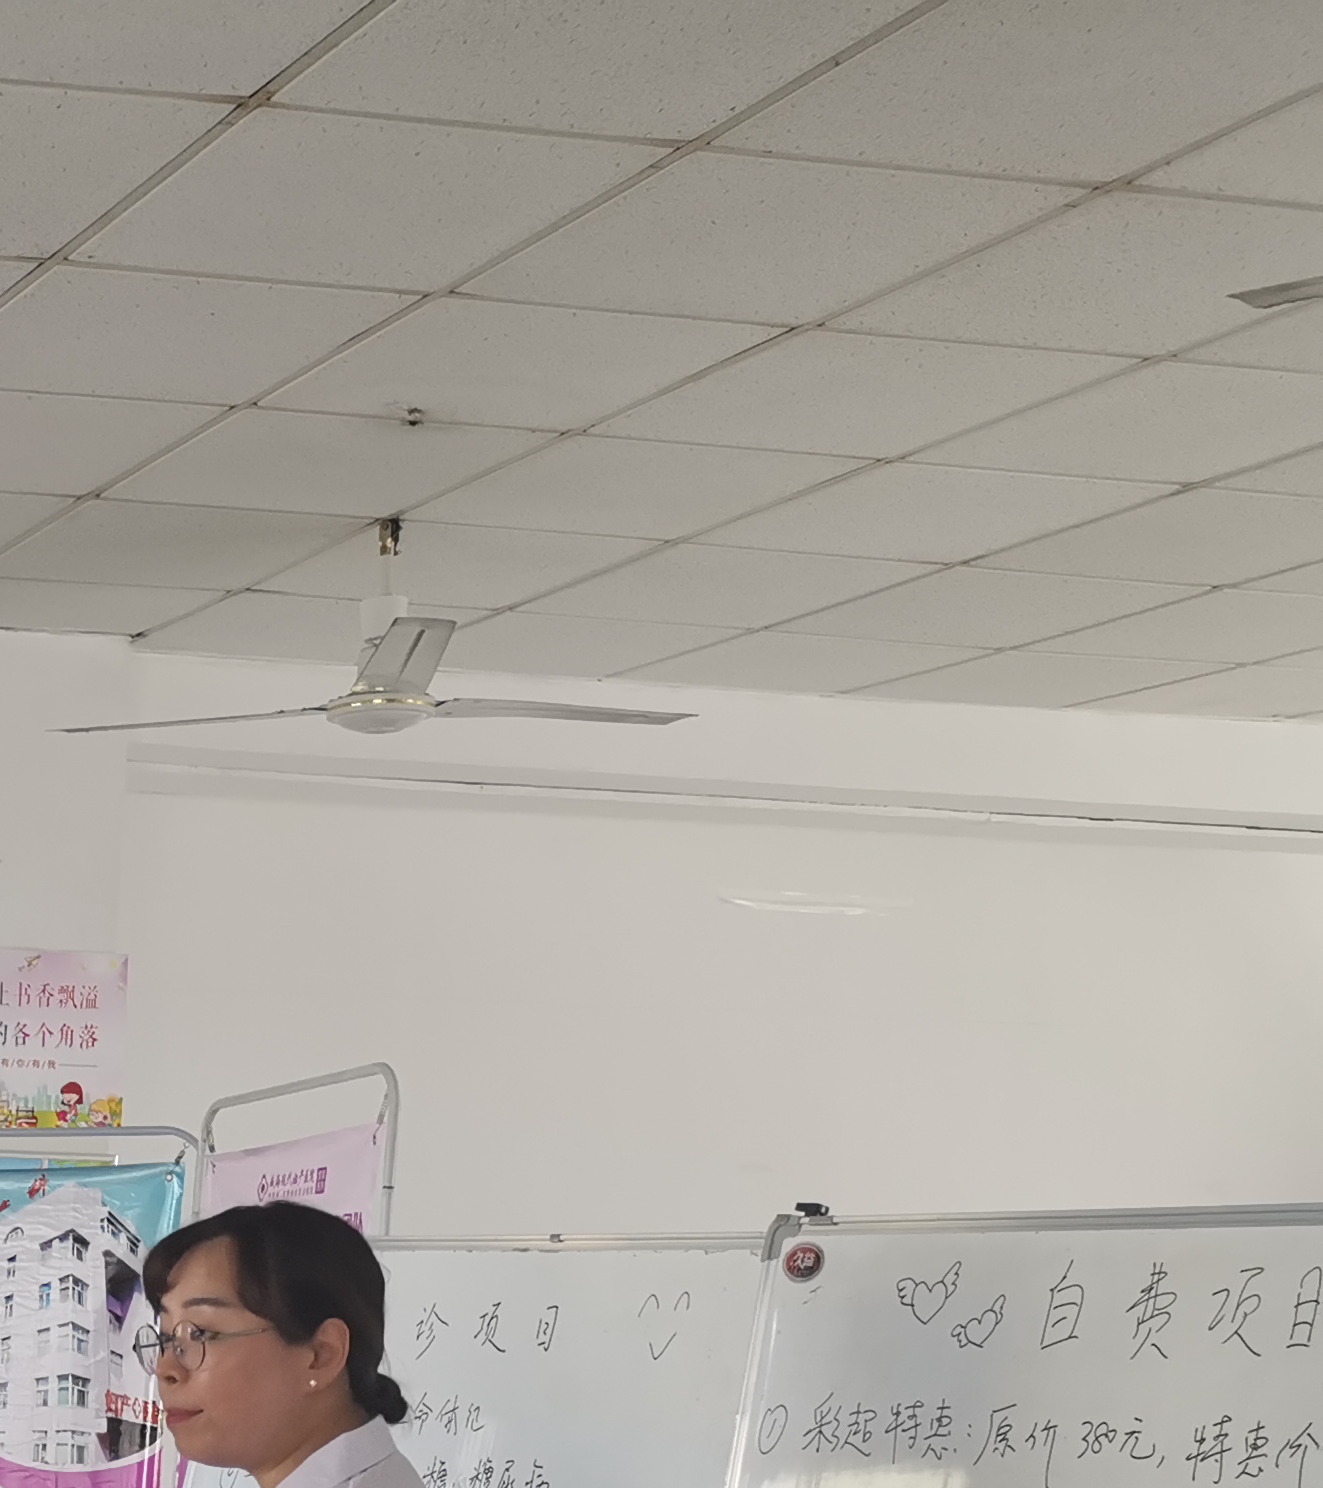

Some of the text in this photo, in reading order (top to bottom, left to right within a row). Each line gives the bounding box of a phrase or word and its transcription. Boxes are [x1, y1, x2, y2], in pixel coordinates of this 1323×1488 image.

[415, 1301, 559, 1361] 诊项目
[1041, 1259, 1323, 1360] 自费项目
